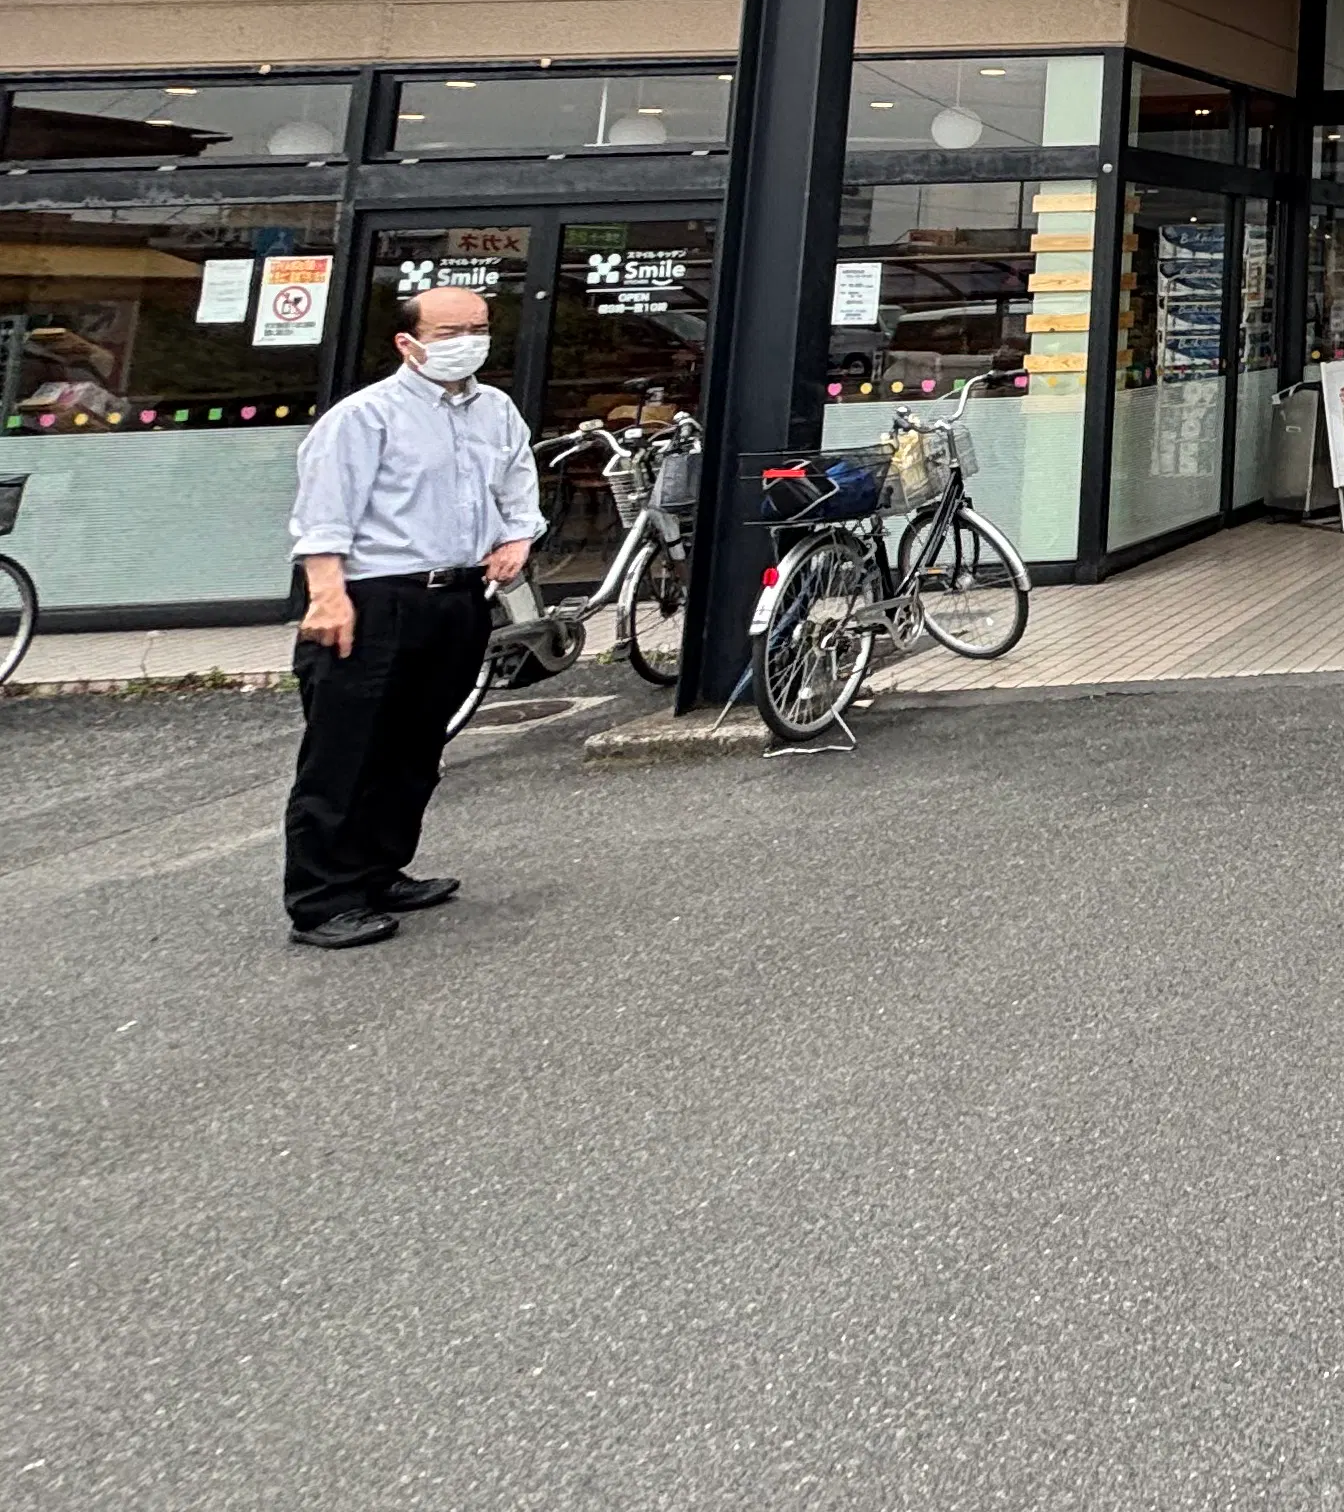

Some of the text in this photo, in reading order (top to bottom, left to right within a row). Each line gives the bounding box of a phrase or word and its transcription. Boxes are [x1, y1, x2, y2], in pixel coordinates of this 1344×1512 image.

[436, 267, 499, 287] Smile
[624, 259, 686, 279] Smile
[618, 292, 651, 302] OPEN
